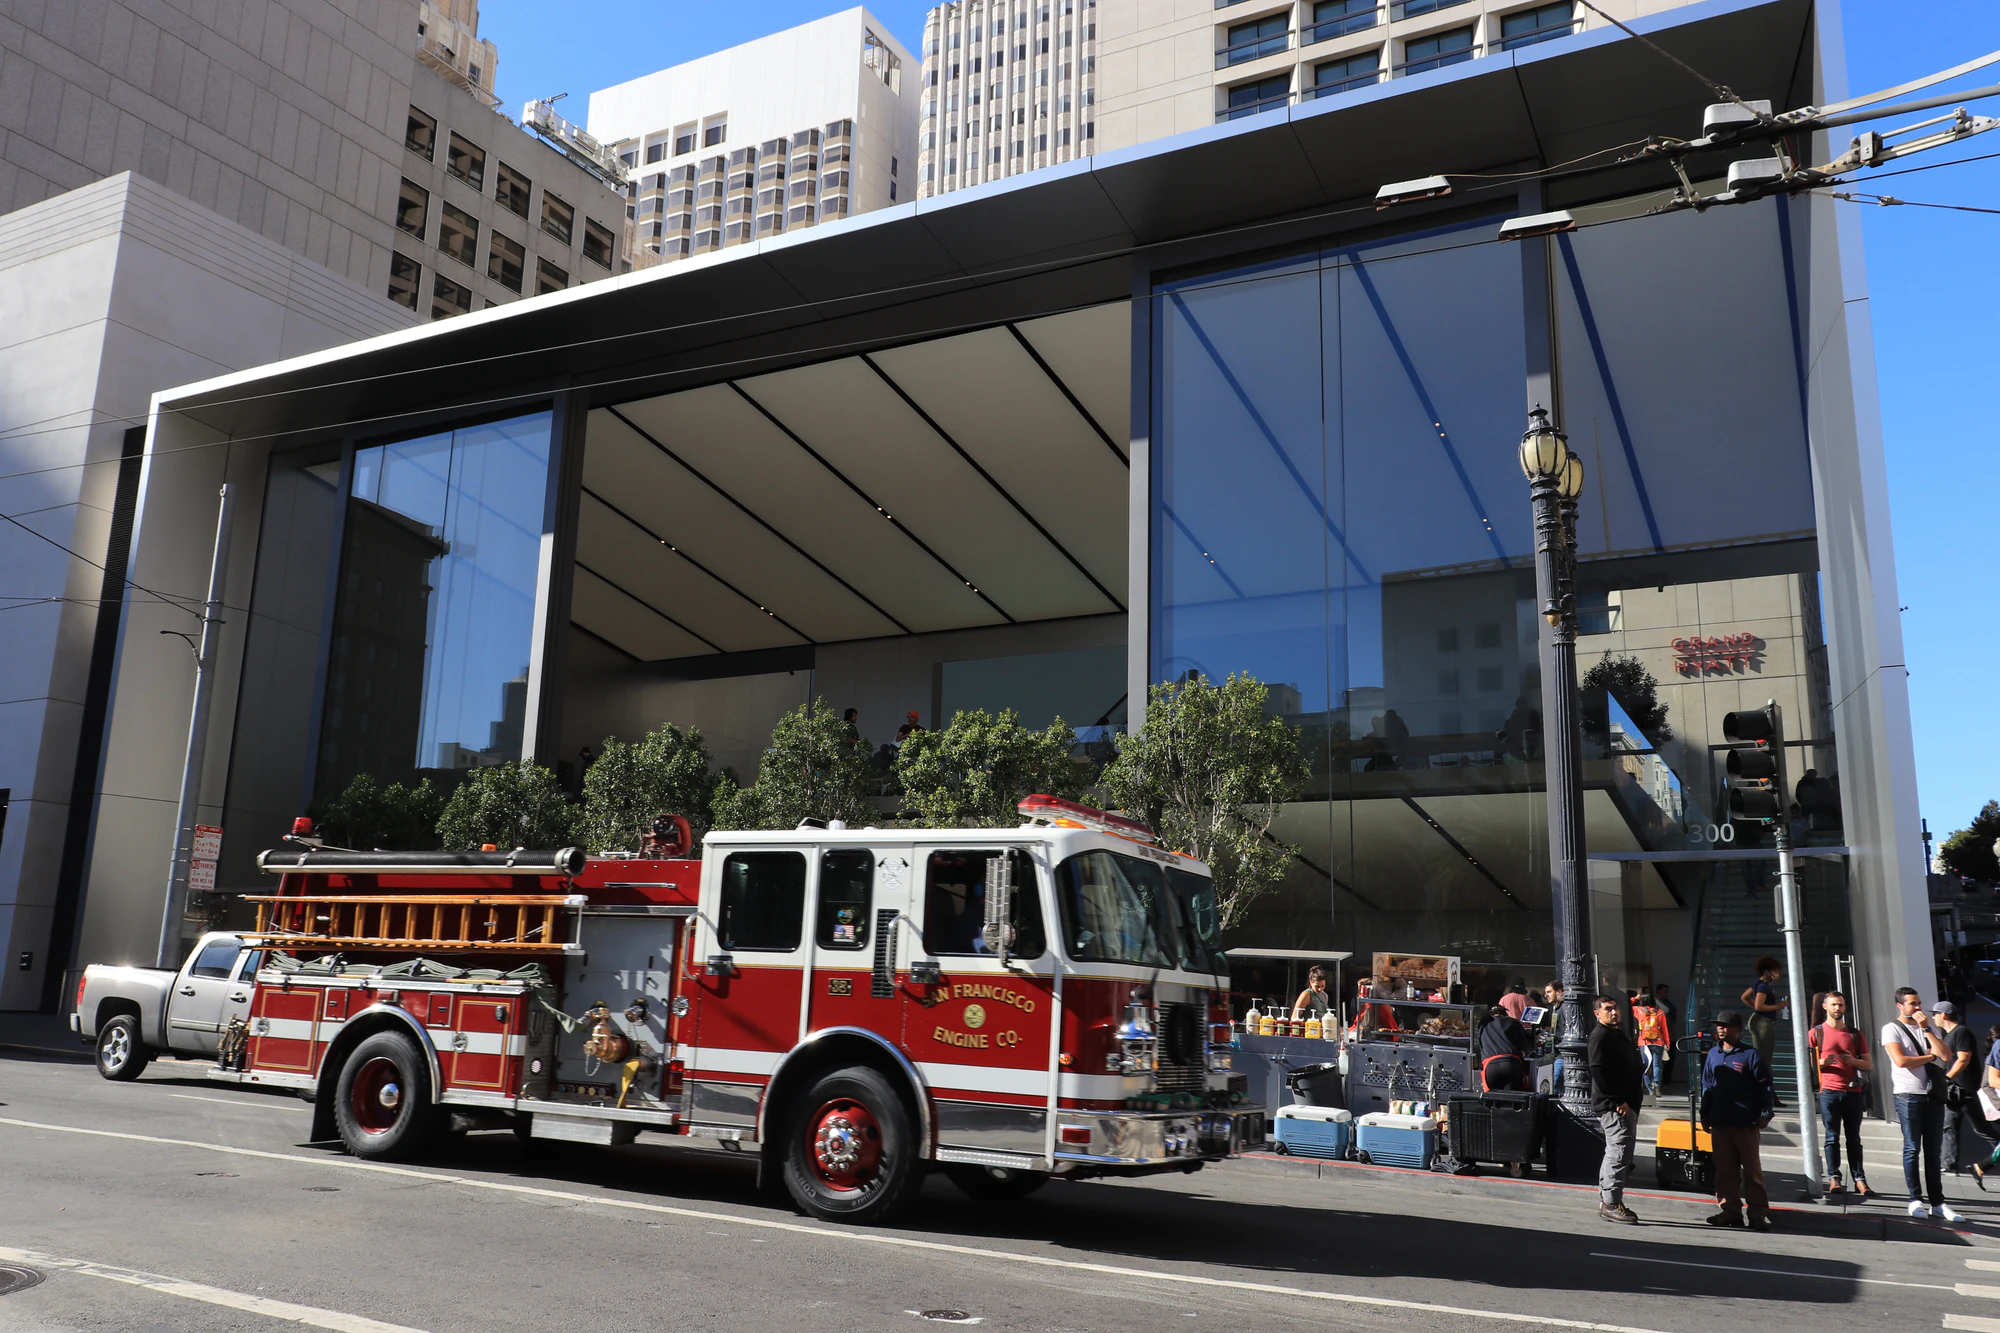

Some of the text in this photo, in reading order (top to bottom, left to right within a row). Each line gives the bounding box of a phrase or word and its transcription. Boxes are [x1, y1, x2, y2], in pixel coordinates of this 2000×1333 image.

[1671, 632, 1754, 650] GRAND
[1674, 654, 1753, 673] HYATT
[1690, 823, 1735, 843] 300
[922, 984, 1035, 1013] SAN FRANCISCO
[932, 1026, 989, 1049] ENGINE
